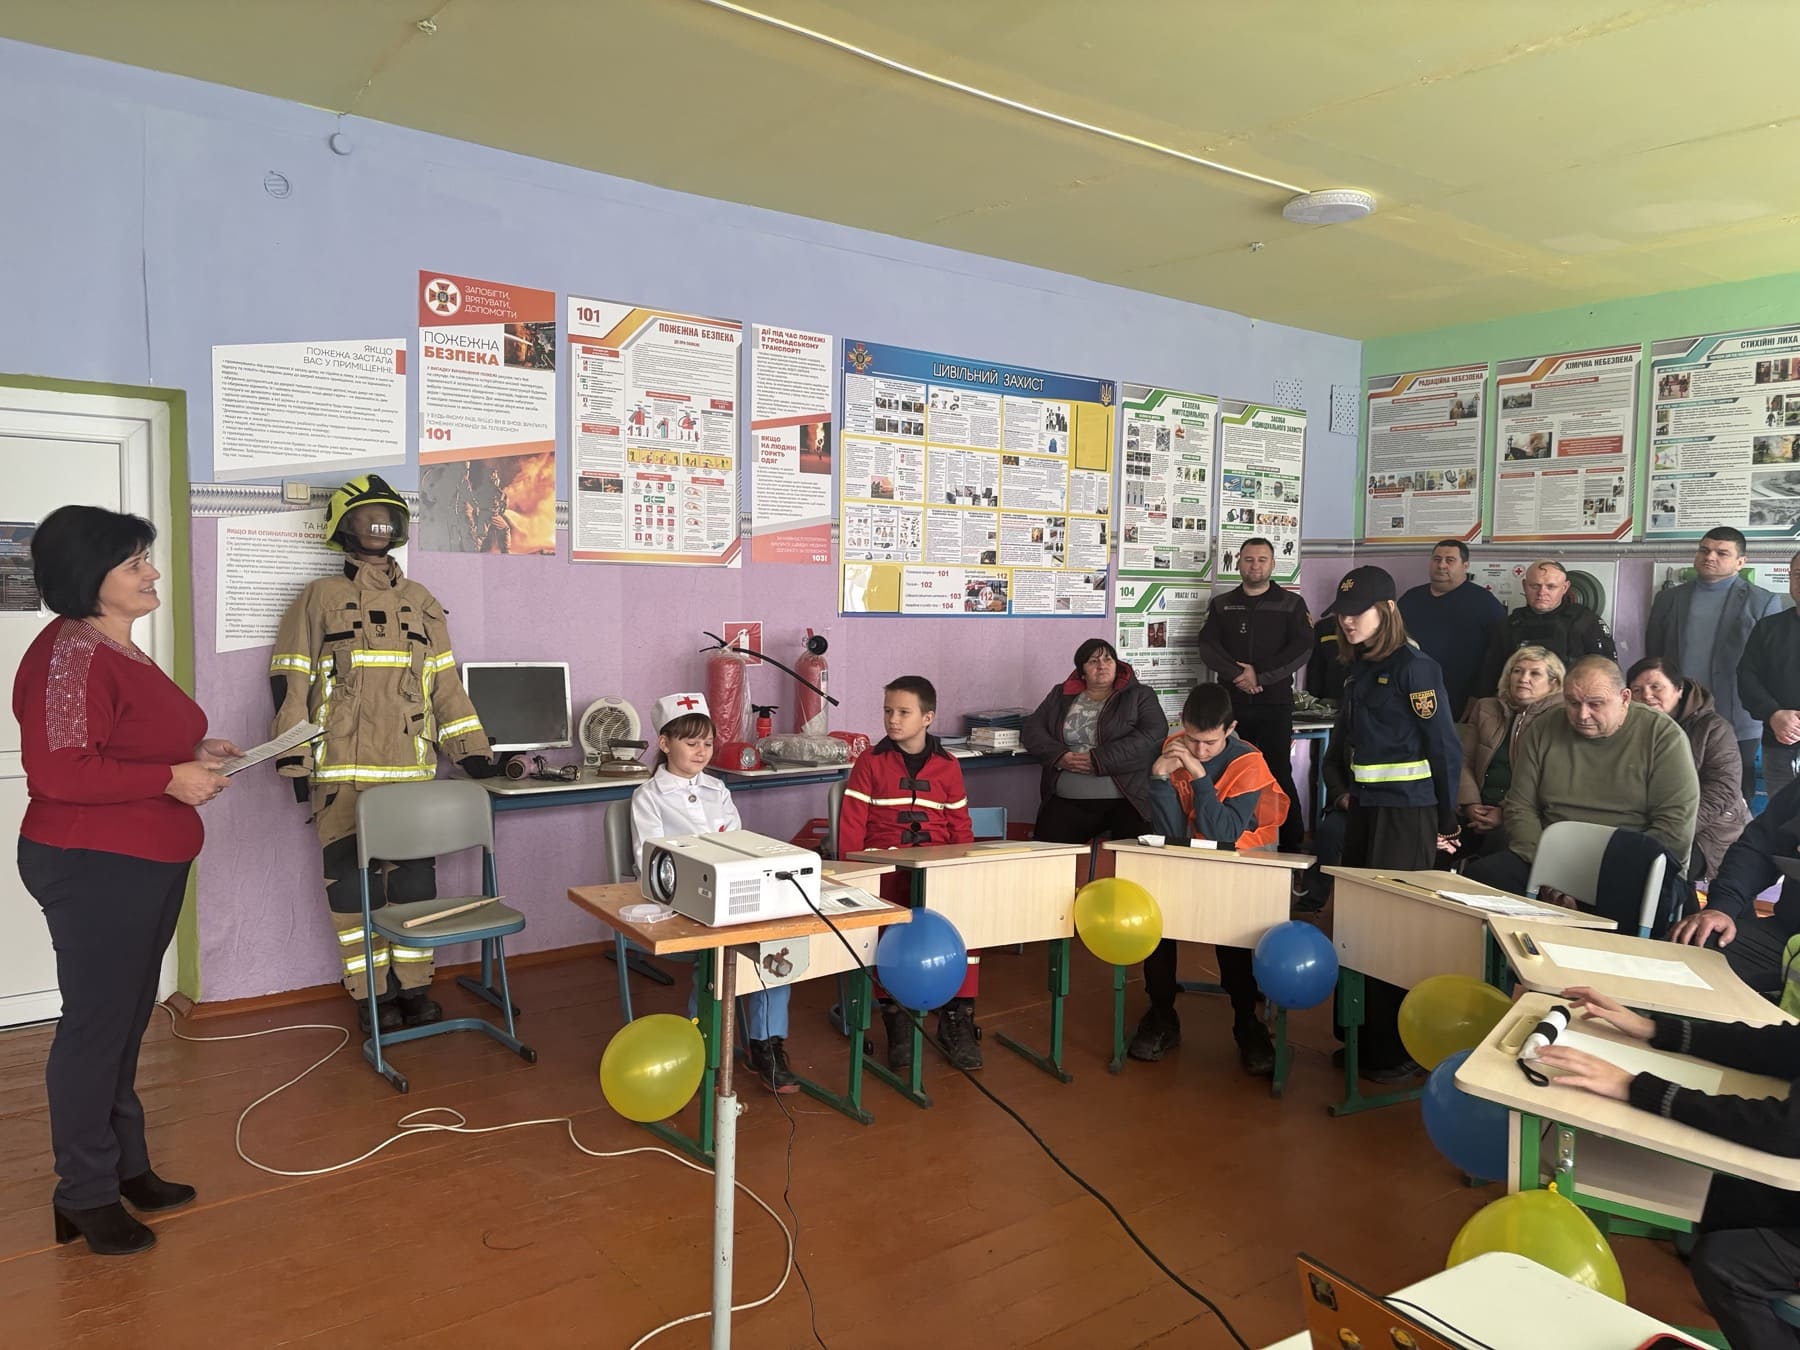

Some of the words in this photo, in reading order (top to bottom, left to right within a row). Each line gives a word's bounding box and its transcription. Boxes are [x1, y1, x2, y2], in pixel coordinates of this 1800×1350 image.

[465, 286, 511, 299] ЗАПОБІГТИ,
[465, 296, 511, 309] ВРЯТУВАТИ,
[577, 307, 600, 322] 101
[659, 323, 699, 337] ПОЖЕЖНА
[701, 329, 734, 343] БЕЗПЕКА
[772, 330, 784, 338] ПІД
[799, 334, 826, 344] ПОЖЕЖІ
[424, 331, 500, 351] ПОЖЕЖНА
[768, 337, 819, 350] ГРОМАДСЬКОМУ
[1741, 337, 1775, 349] СТИХІЙНІ
[1776, 335, 1799, 345] ЛИХА
[306, 347, 351, 360] ПОЖЕЖА
[352, 352, 393, 365] ЗАСТАЛА
[364, 345, 393, 356] ЯКЩО
[424, 345, 500, 365] БЕЗПЕКА
[761, 344, 801, 355] ТРАНСПОРТІ
[303, 356, 323, 367] ВАС
[325, 359, 332, 367] У
[1565, 360, 1593, 370] ХІМІЧНА
[1594, 355, 1633, 368] НЕБЕЗПЕКА
[933, 363, 998, 385] ЦИВІЛЬНИЙ
[1003, 373, 1045, 392] ЗАХИСТ
[426, 427, 451, 441] 101
[761, 450, 785, 458] ГОРИТЬ
[770, 444, 797, 452] ЛЮДИНІ
[761, 457, 778, 465] ОДЯГ
[303, 522, 314, 530] ТА
[980, 592, 993, 601] 112
[1120, 586, 1135, 597] 104
